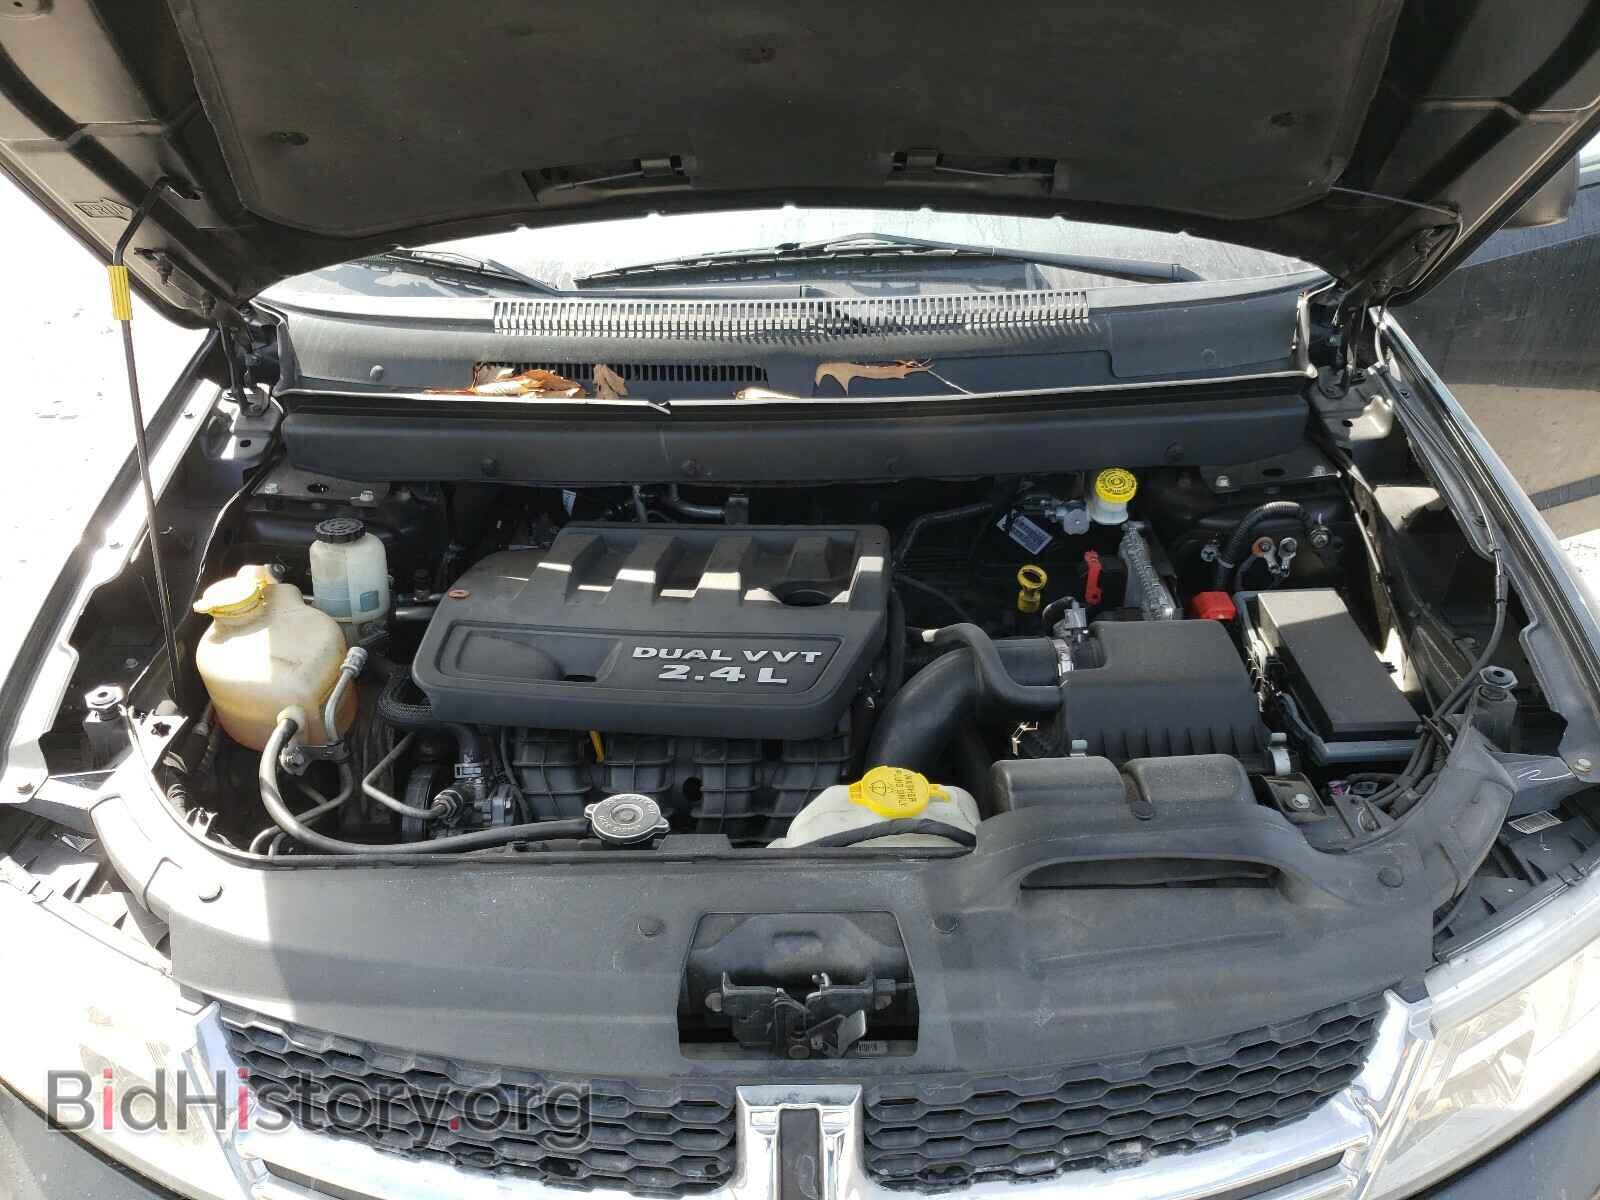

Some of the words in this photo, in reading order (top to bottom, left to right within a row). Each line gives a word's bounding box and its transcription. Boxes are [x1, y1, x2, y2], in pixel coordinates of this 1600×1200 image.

[632, 646, 733, 661] DUAL
[743, 650, 823, 663] VVT
[658, 664, 746, 682] 2.4
[757, 667, 788, 684] L
